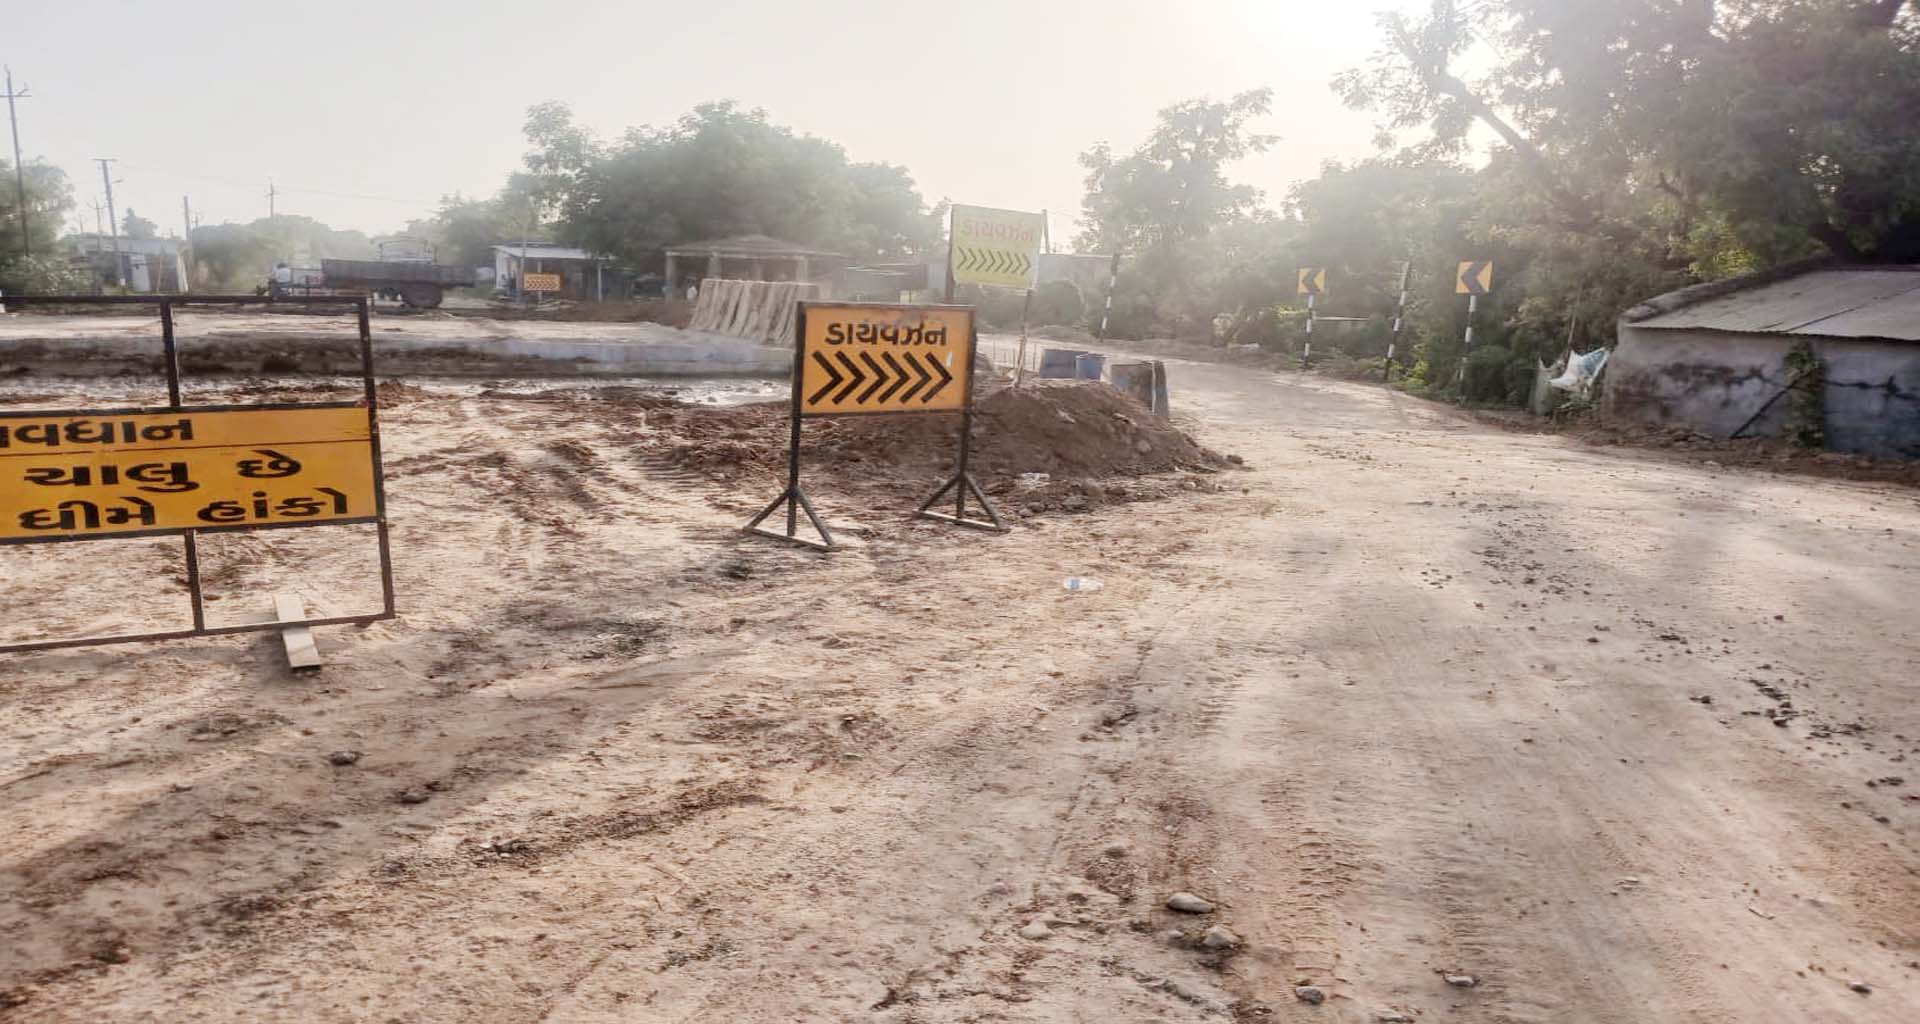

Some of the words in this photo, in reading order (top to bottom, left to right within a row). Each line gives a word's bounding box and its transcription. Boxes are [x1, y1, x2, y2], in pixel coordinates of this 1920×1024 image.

[24, 461, 200, 493] ચાલુ
[236, 449, 302, 479] છે
[19, 496, 156, 530] ધીમે
[197, 487, 348, 523] હાંકો
